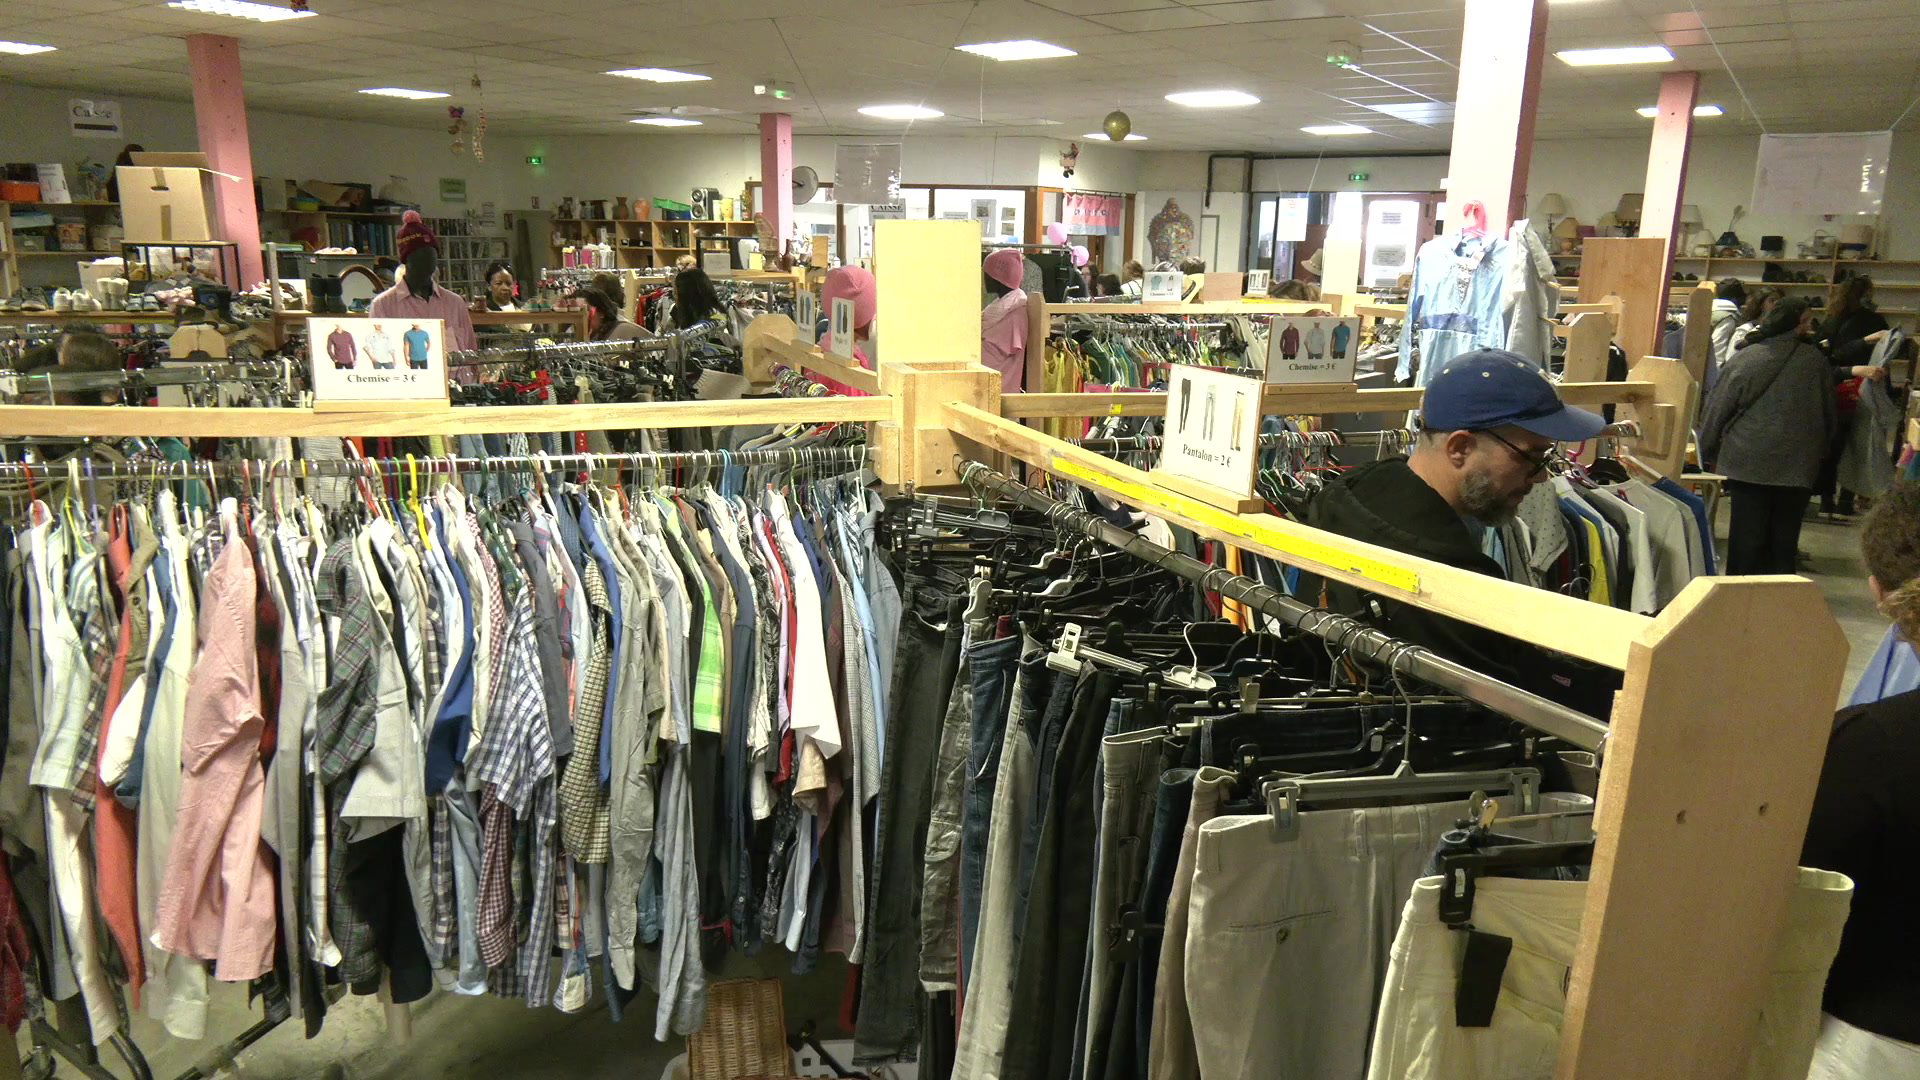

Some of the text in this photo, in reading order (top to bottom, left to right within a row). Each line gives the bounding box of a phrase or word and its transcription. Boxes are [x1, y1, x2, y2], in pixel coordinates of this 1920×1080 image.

[72, 105, 112, 118] Casse
[1289, 363, 1317, 371] Chemise
[347, 374, 390, 383] Chemise
[403, 374, 408, 383] 3
[411, 374, 416, 383] €
[1183, 443, 1212, 462] Pantalon
[1221, 455, 1225, 466] 2
[1227, 456, 1231, 468] €
